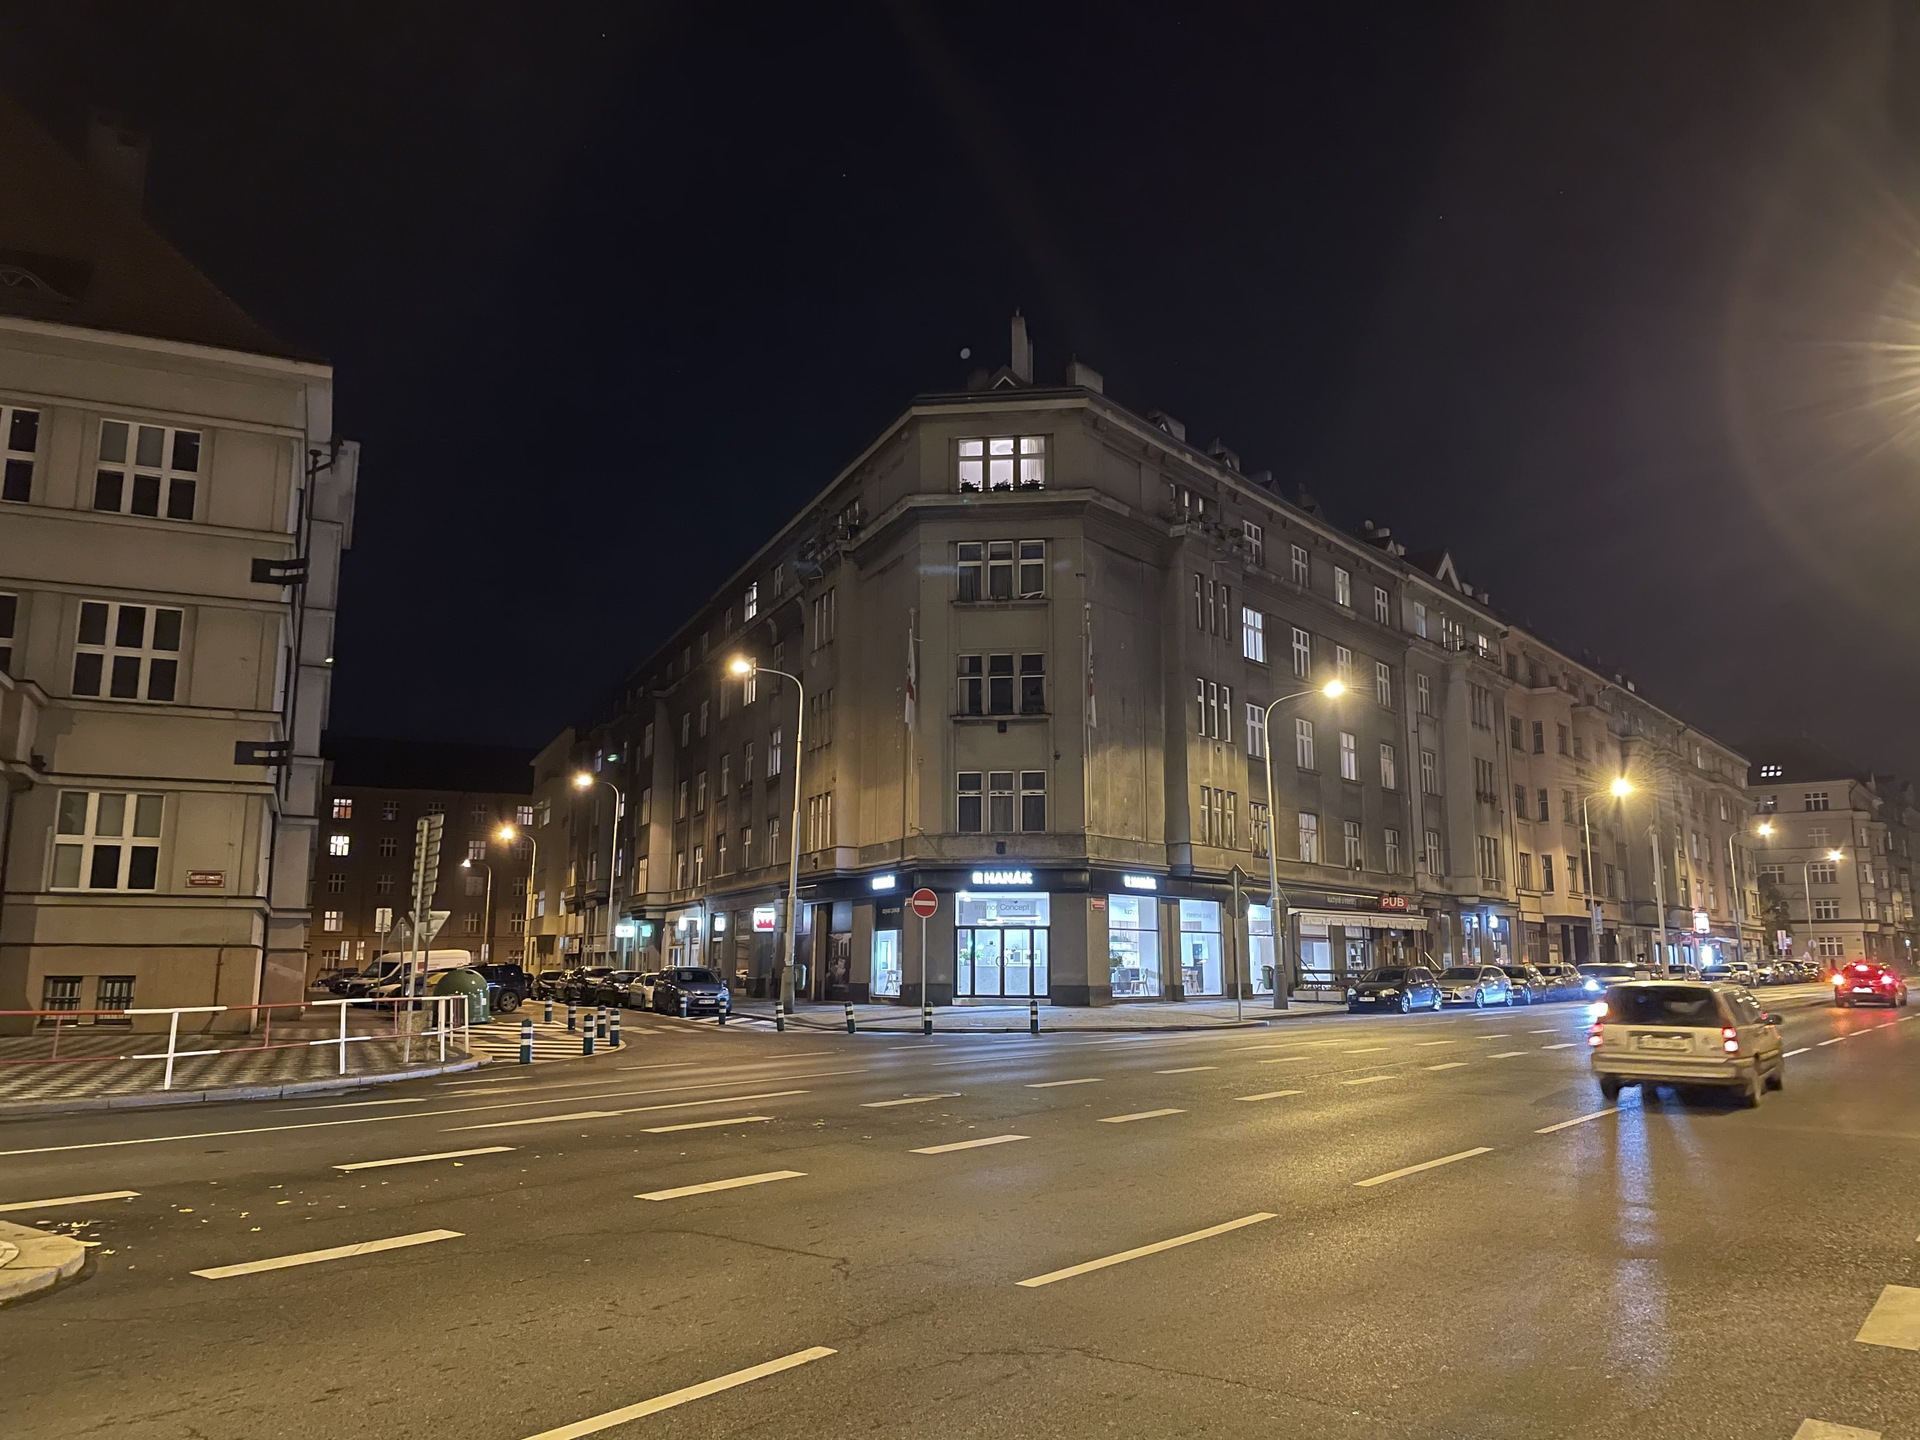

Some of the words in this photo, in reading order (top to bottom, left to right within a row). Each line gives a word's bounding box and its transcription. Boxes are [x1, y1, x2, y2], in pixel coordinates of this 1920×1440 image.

[983, 870, 1033, 885] HANÁK
[1000, 903, 1030, 911] Concept
[1382, 897, 1405, 907] PUB
